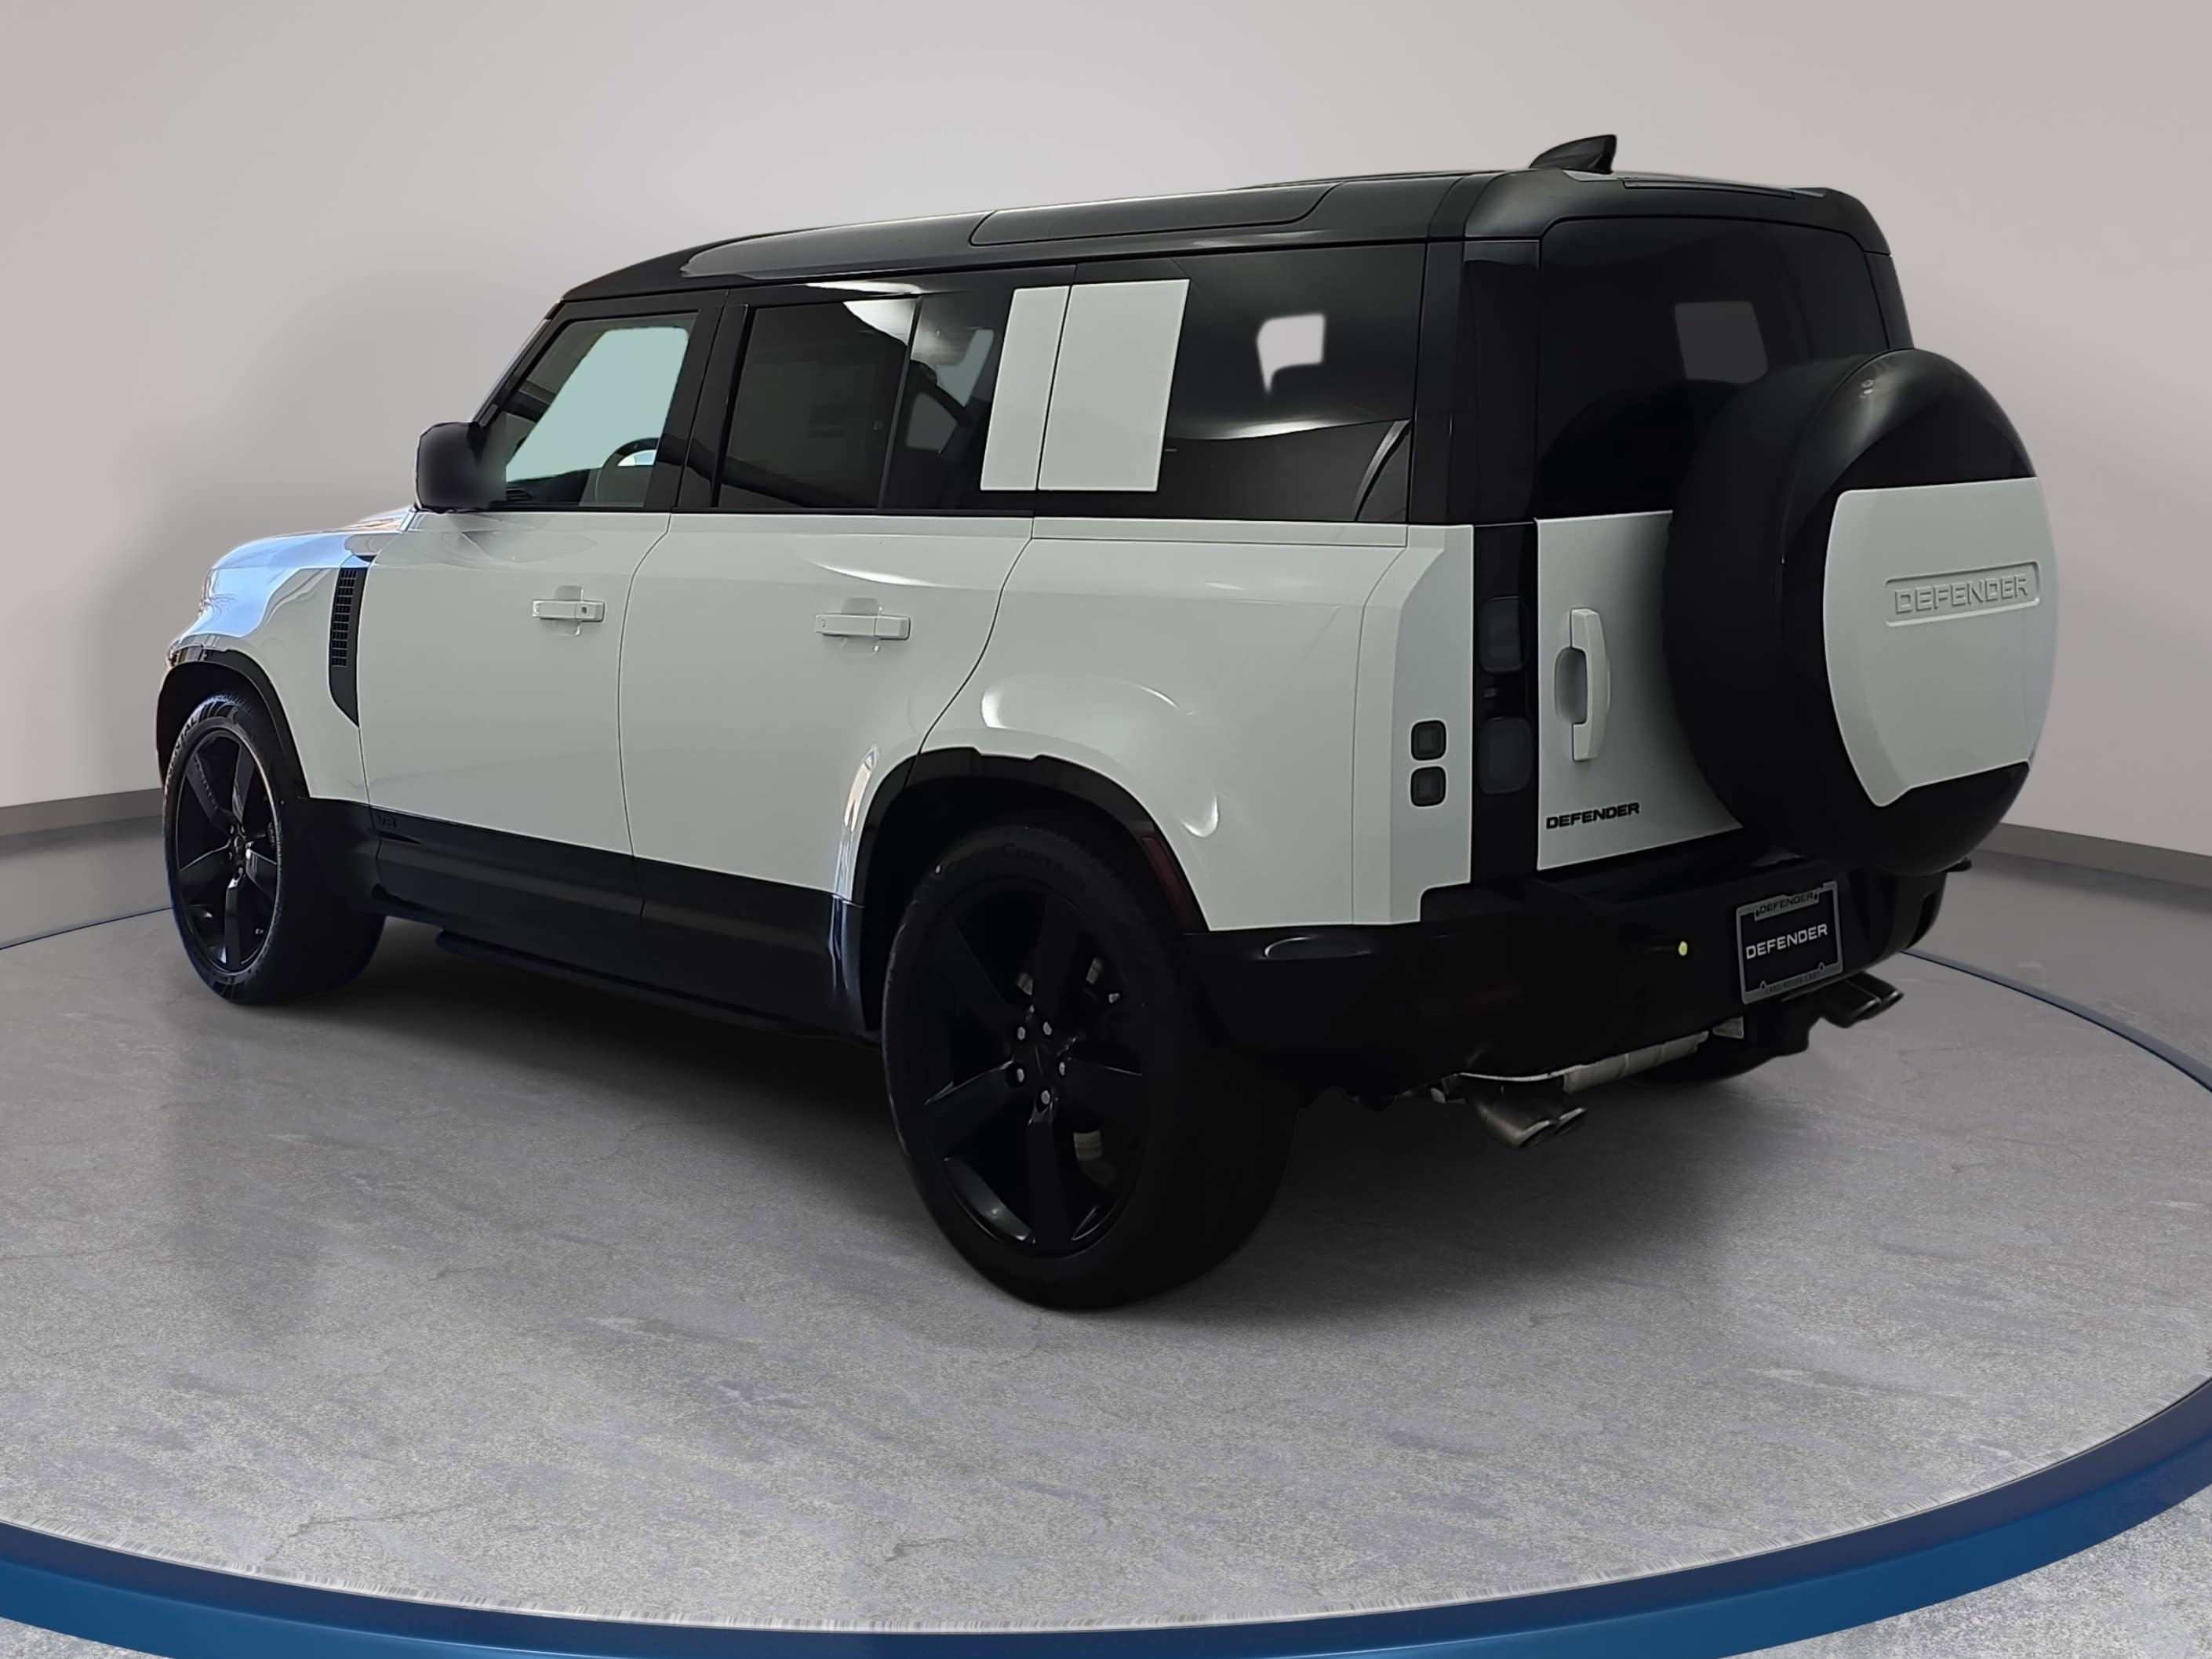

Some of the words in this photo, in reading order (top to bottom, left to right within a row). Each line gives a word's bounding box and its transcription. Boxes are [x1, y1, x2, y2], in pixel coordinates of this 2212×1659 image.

[1894, 574, 2028, 613] DEFENDER
[1546, 802, 1639, 829] DEFENDER
[1759, 891, 1814, 914] DEFENDER
[1745, 923, 1828, 959] DEFENDER
